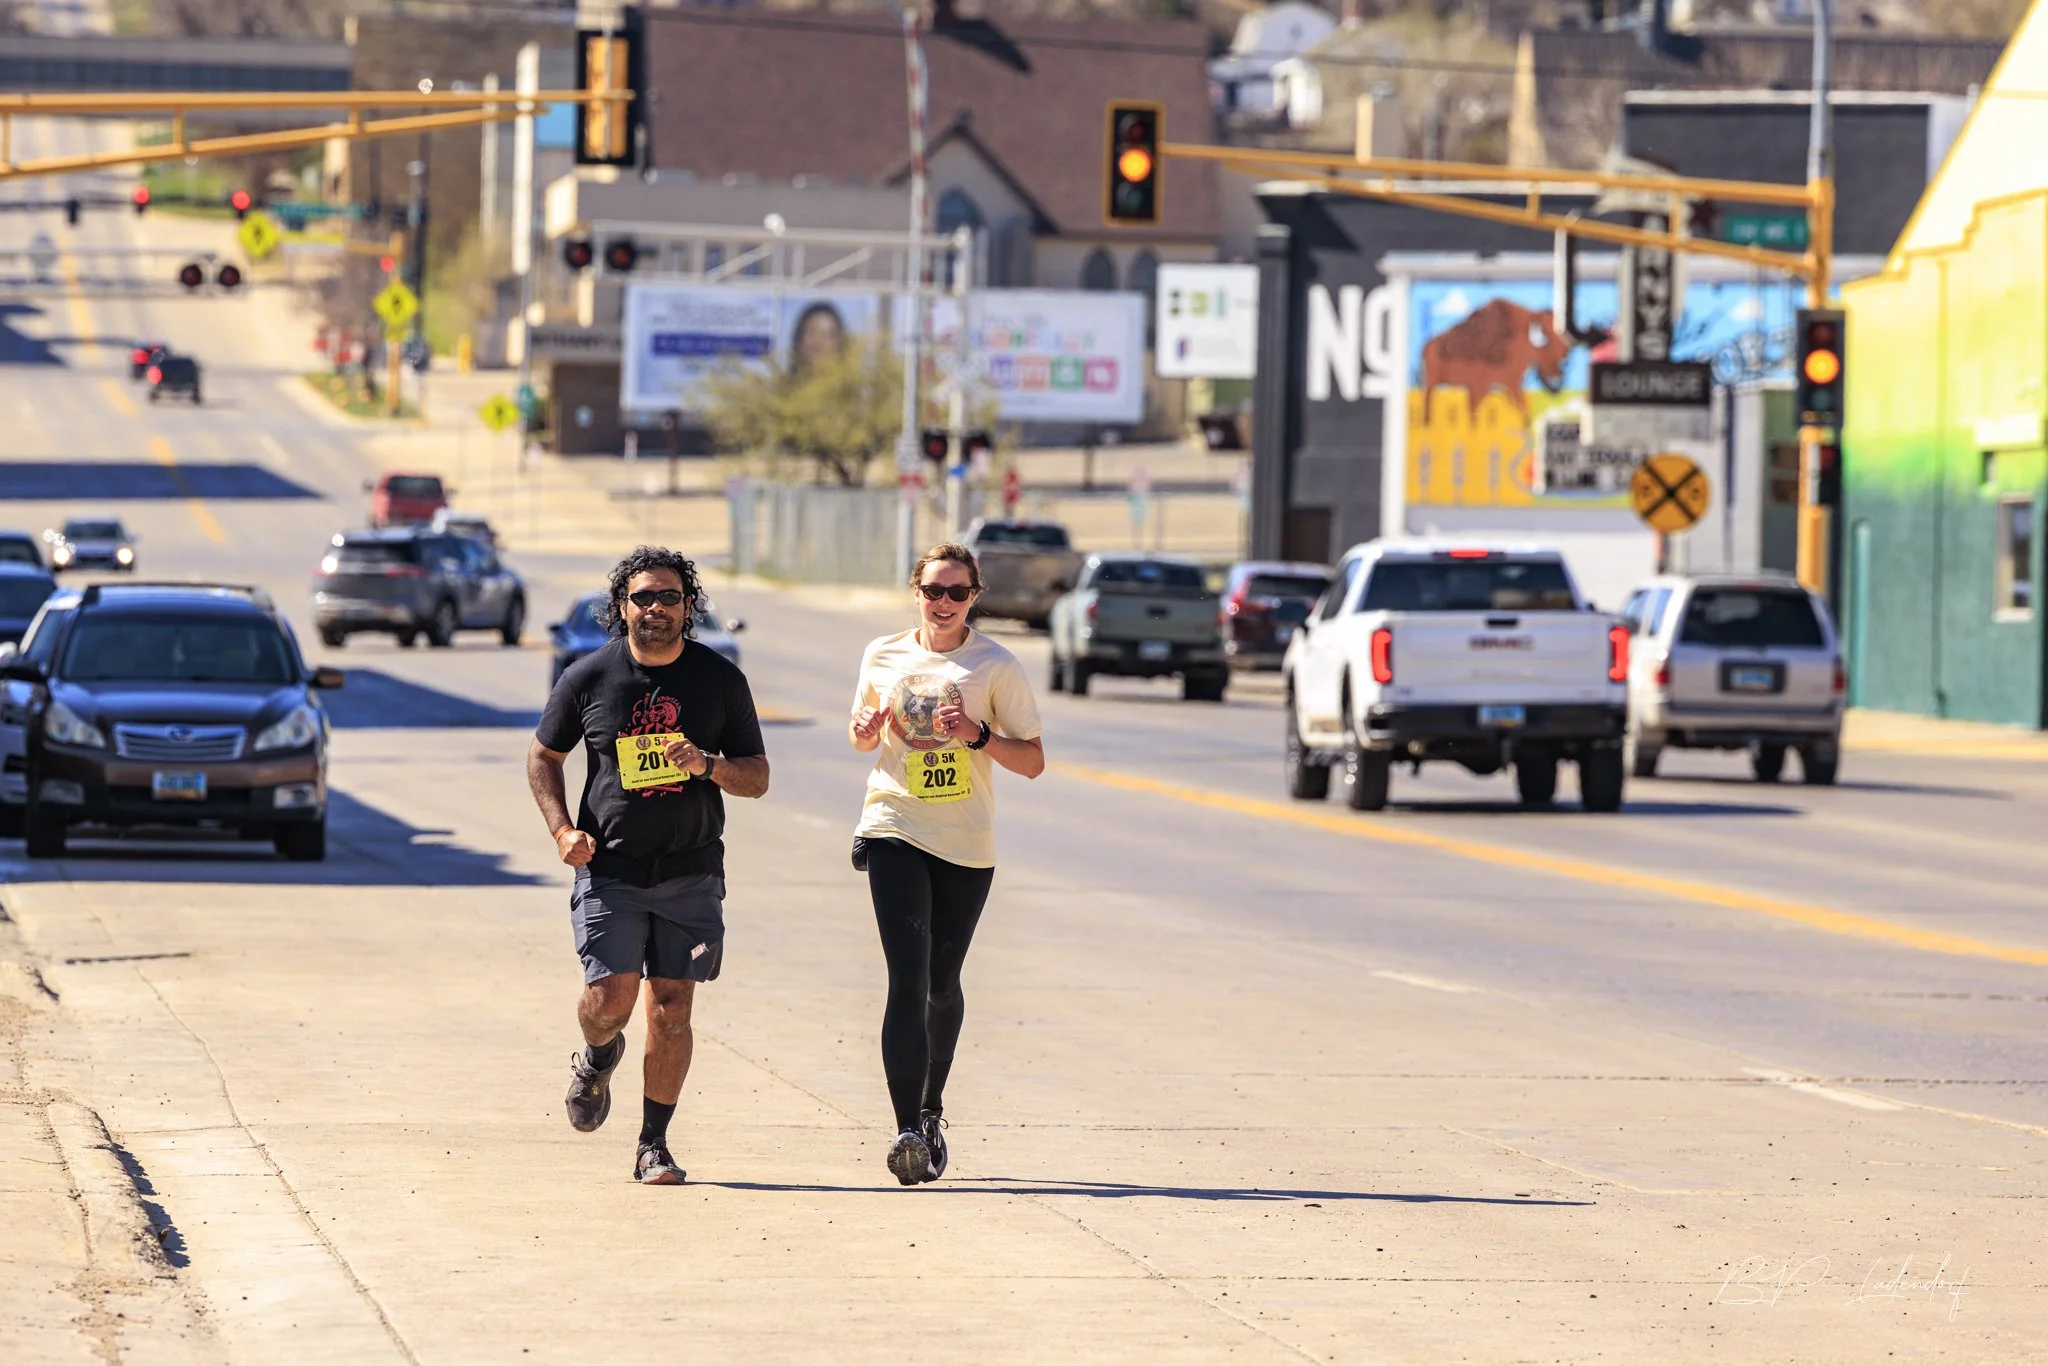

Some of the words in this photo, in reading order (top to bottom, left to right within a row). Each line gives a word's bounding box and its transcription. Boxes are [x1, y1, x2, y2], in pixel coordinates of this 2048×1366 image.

[1601, 371, 1704, 399] LOUNGE
[947, 685, 961, 705] DOG
[637, 750, 669, 772] 201
[941, 752, 956, 764] 5K
[923, 767, 957, 788] 202
